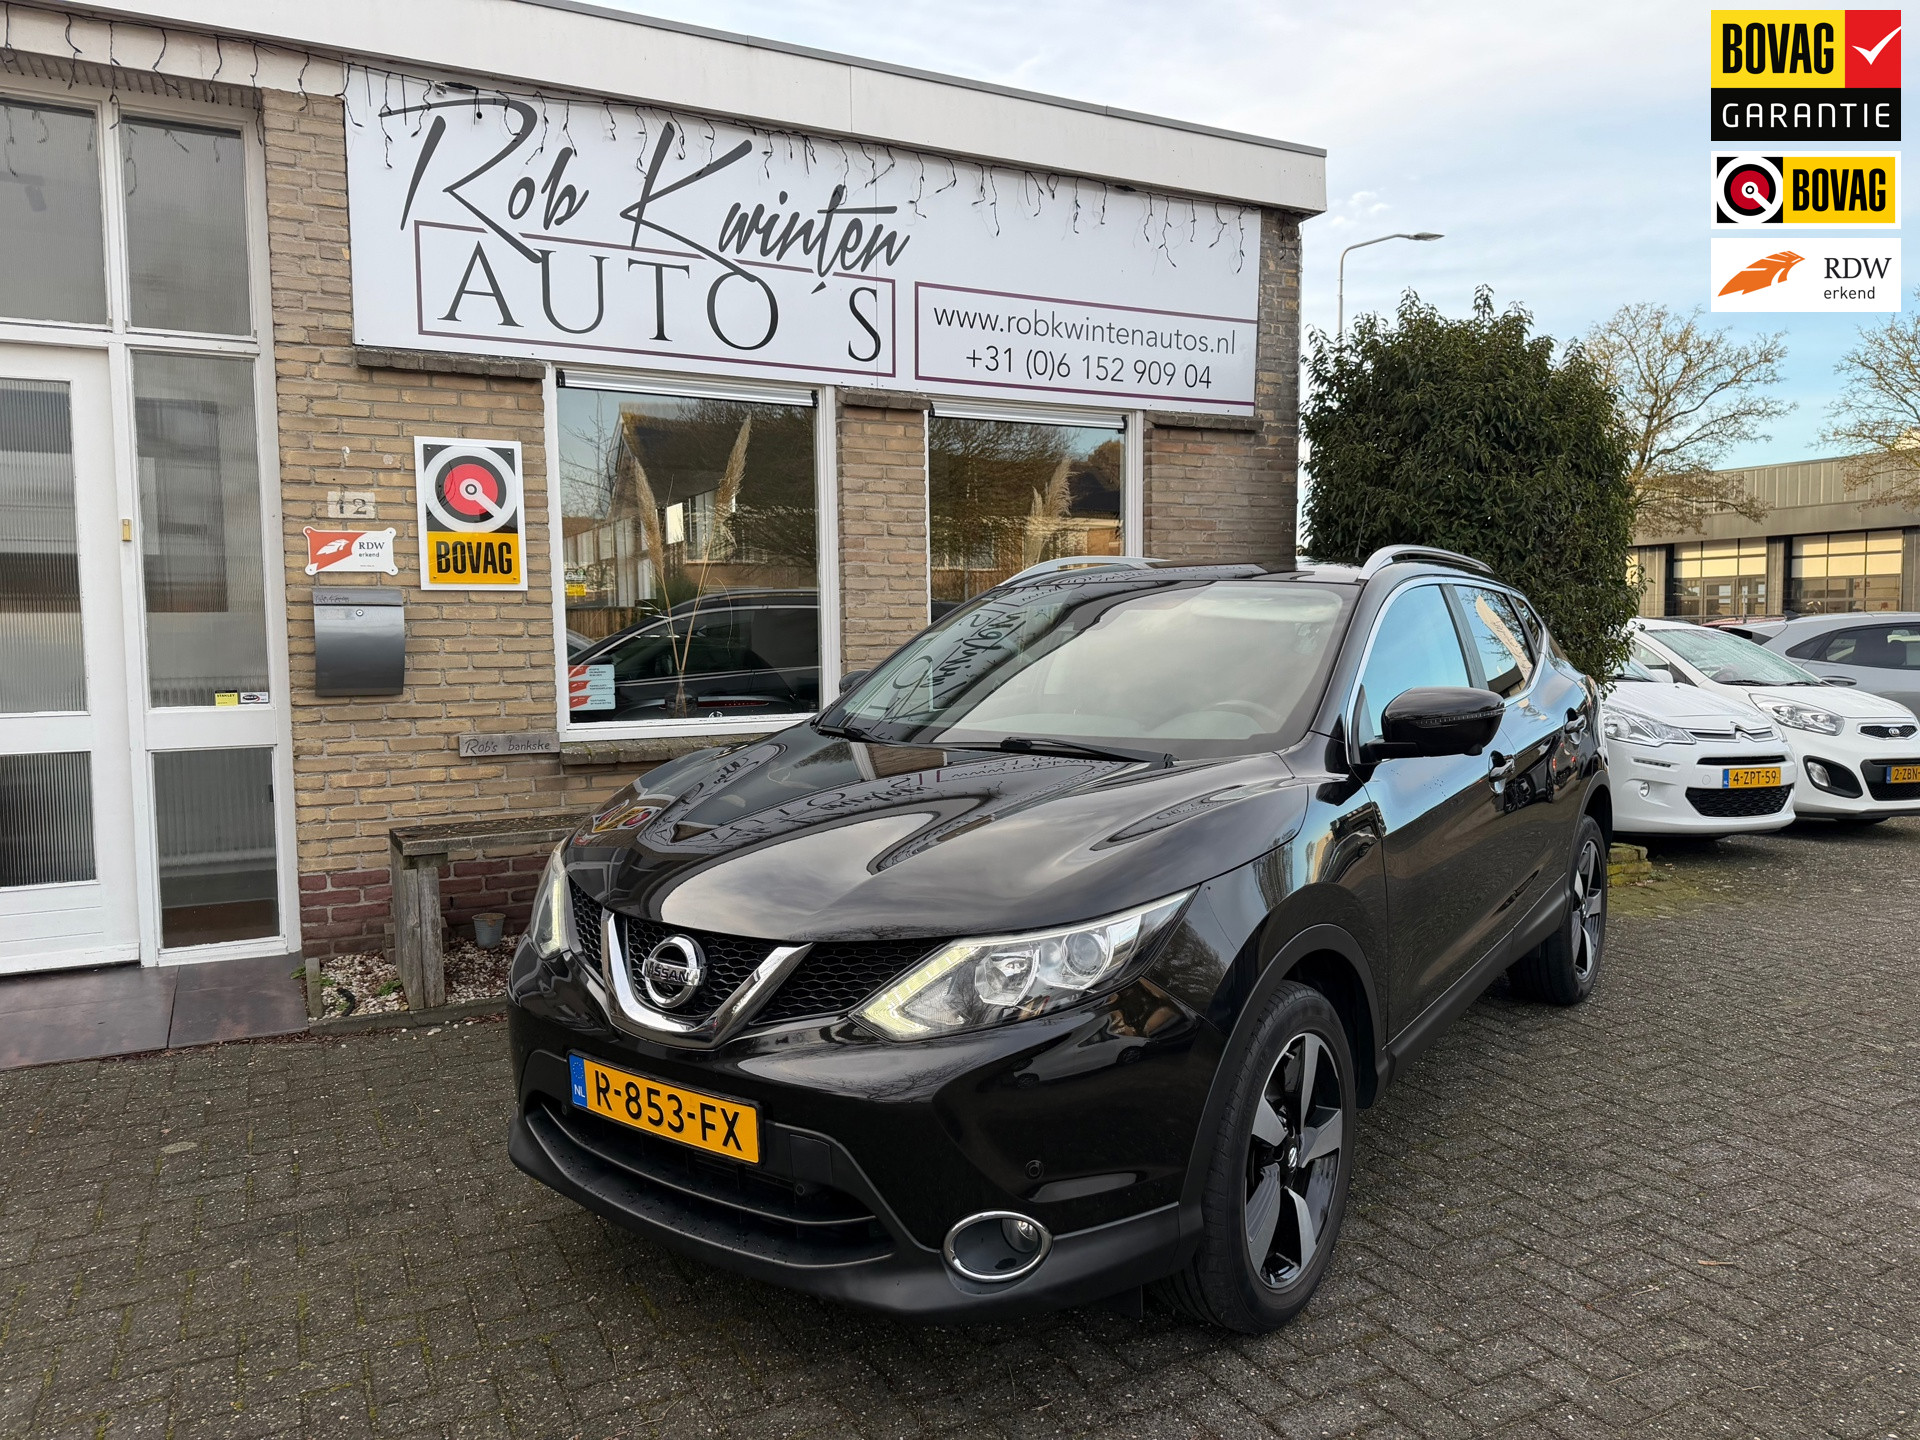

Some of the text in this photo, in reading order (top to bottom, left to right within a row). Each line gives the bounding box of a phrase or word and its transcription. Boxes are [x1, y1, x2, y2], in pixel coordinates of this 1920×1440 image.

[378, 97, 910, 283] Rob Kwinten
[933, 306, 1236, 355] www.robkwintenautos.nl
[966, 345, 1212, 389] +31 (0)6 152 909 04
[358, 541, 385, 550] RDW
[435, 540, 513, 575] BOVAG
[464, 738, 550, 755] Rob's bankske
[1732, 770, 1777, 785] 4-ZPT-59
[645, 961, 690, 982] NISSAN
[573, 1069, 743, 1152] NL R-853-FX
